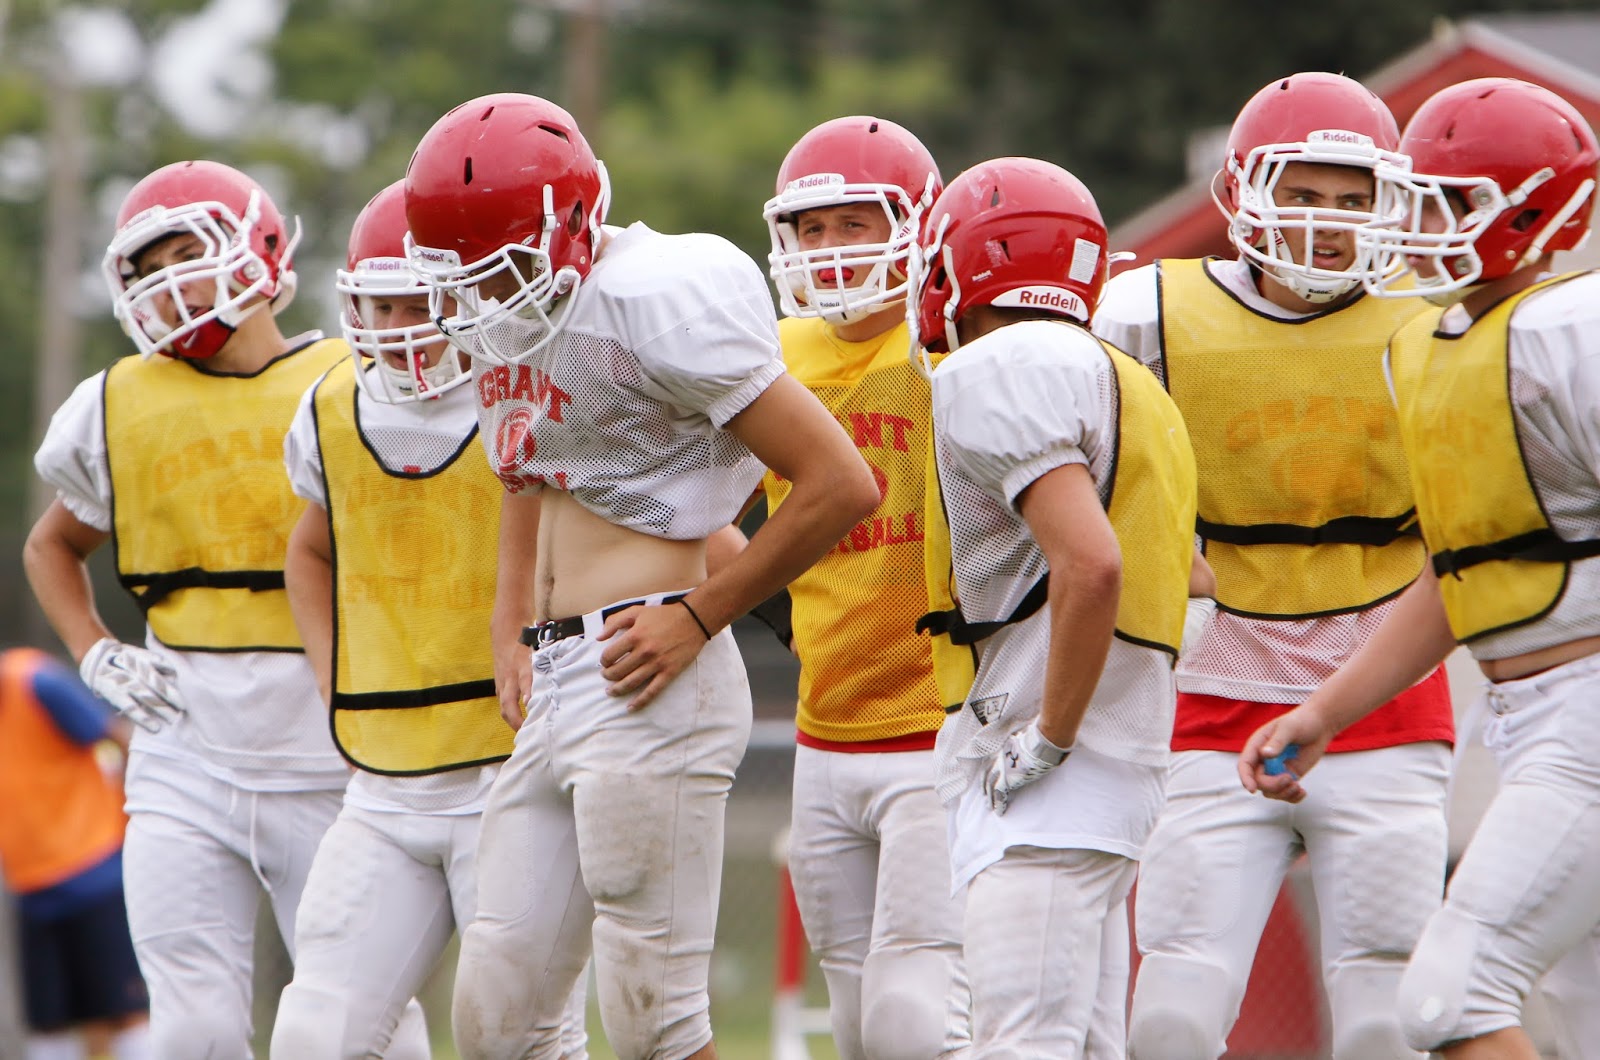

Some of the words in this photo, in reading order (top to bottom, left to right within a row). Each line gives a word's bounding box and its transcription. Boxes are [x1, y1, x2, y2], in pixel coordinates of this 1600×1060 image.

[1323, 132, 1359, 143] Riddell
[798, 176, 830, 188] Riddell
[369, 261, 400, 271] Riddell
[1019, 290, 1078, 312] Riddell
[478, 364, 572, 425] GRANT
[828, 512, 925, 555] BALL
